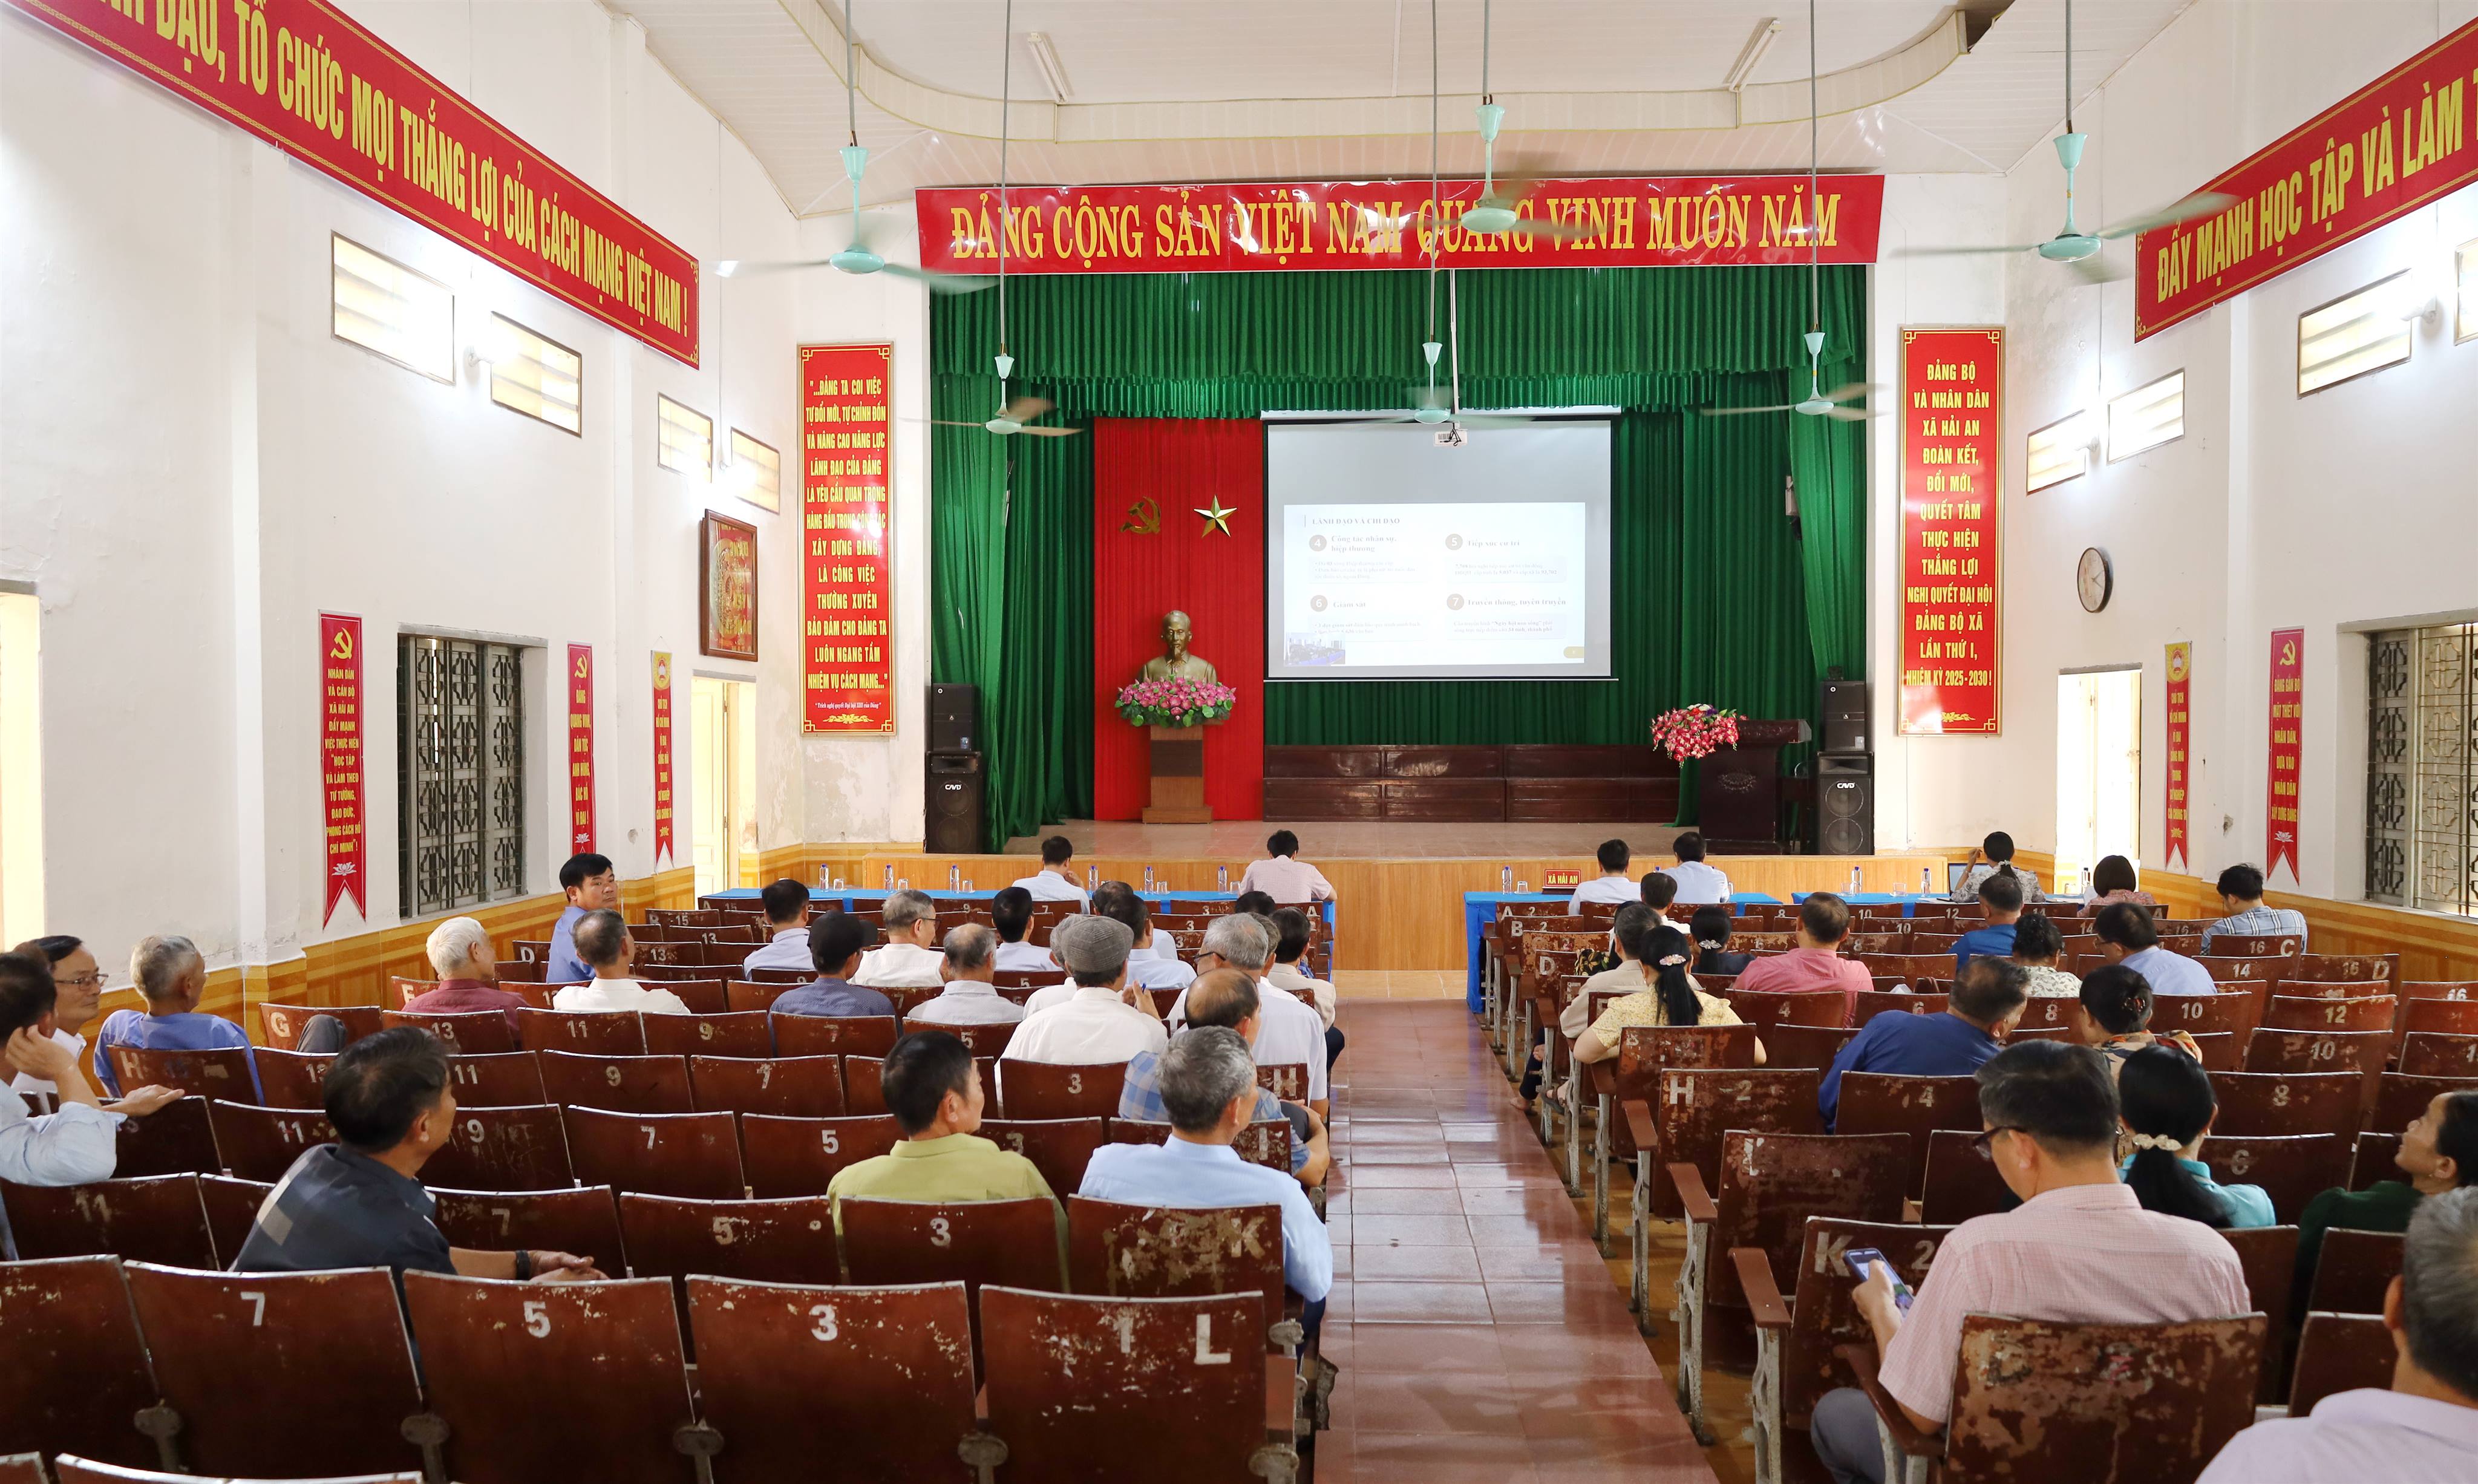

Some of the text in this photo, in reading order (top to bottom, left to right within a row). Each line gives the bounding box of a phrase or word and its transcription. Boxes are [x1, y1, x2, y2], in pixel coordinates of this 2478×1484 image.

[277, 27, 344, 140] CHỨC
[351, 73, 394, 182] MỌI
[400, 98, 466, 214] THẮNG
[471, 151, 498, 242] LỢI
[503, 160, 536, 253] CỦA
[540, 192, 580, 278] CÁCH
[584, 224, 623, 304] MẠNG
[626, 247, 652, 326] VIỆT
[655, 267, 680, 334] NAM
[2157, 216, 2192, 303] ĐẨY
[2195, 197, 2254, 286] MẠNH
[2260, 171, 2303, 257] HỌC
[2309, 137, 2353, 233] TẬP
[2361, 105, 2395, 198] VÀ
[2402, 77, 2463, 179] LÀM
[950, 193, 1044, 259] ĐẢNG
[1053, 195, 1143, 268] CỘNG
[1156, 190, 1221, 257] SẢN
[1234, 189, 1317, 264] VIỆT
[1326, 198, 1402, 253] NAM
[1546, 197, 1636, 252] VINH
[1646, 183, 1751, 249] MUÔN
[1759, 185, 1842, 247] NĂM
[1927, 359, 1976, 384] ĐẢNG BỘ
[840, 379, 849, 395] TA
[851, 379, 863, 395] COI
[866, 375, 881, 398] VIỆC
[1914, 388, 1989, 408] VÀ NHÂN DÂN
[805, 400, 886, 426] TỰ ĐỔI MỚI, TỰ CHỈNH ĐỐN
[1923, 414, 1980, 436] XÃ HẢI AN
[806, 430, 885, 452] VÀ NÂNG CAO NĂNG LỰC
[1923, 443, 1979, 466] ĐOÀN KẾT,
[810, 454, 881, 479] LÃNH ĐẠO CỦA ĐẢNG
[806, 481, 886, 505] LÀ YÊU CẦU QUAN TRỌNG
[1926, 469, 1974, 494] ĐỔI MỚI,
[806, 510, 822, 529] HÀNG
[823, 508, 835, 529] ĐẦU
[1920, 498, 1981, 521] QUYẾT TÂM
[812, 537, 827, 556] XÂY
[831, 538, 852, 559] DỰNG
[1451, 537, 1458, 546] 5
[1921, 528, 1979, 551] THỰC HIỆN
[818, 563, 875, 586] LÀ CÔNG VIỆC
[1921, 554, 1978, 578] THẮNG LỢI
[817, 590, 877, 609] THƯỜNG XUYÊN
[1315, 598, 1322, 607] 6
[1452, 598, 1459, 606] 7
[1908, 581, 1992, 607] NGHỊ QUYẾT ĐẠI HỘI
[807, 615, 887, 636] BẢO ĐẢM CHO ĐẢNG TA
[1915, 609, 1983, 634] ĐẢNG BỘ XÃ
[815, 641, 880, 662] LUÔN NGANG TẦM
[1920, 636, 1941, 659] LẦN
[1945, 639, 1967, 658] THỨ
[808, 670, 829, 693] NHIỆM
[831, 673, 839, 693] VỤ
[840, 670, 858, 689] CÁCH
[1906, 666, 1931, 689] NHIỆM
[1934, 667, 1943, 686] KỲ
[347, 704, 355, 714] AN
[346, 773, 359, 783] THEO
[1548, 872, 1578, 884] XÃ HẢI AN
[1511, 921, 1523, 937] B
[2250, 939, 2295, 958] 16 C
[1539, 957, 1555, 975] D
[2372, 960, 2389, 980] D
[2182, 1002, 2203, 1020] 10
[2325, 1006, 2346, 1023] 12
[270, 1012, 290, 1038] G
[567, 1021, 587, 1038] 11
[699, 1022, 713, 1041] 9
[2312, 1041, 2335, 1060] 10
[454, 1064, 478, 1085] 11
[606, 1065, 621, 1087] 9
[757, 1064, 771, 1089] 7
[1067, 1073, 1082, 1094] 3
[1669, 1076, 1752, 1104] H 2
[467, 1120, 484, 1142] 9
[641, 1126, 656, 1149] 7
[822, 1129, 839, 1154] 5
[929, 1217, 952, 1247] 3
[1815, 1231, 1851, 1276] K
[240, 1291, 265, 1327] 7
[523, 1301, 550, 1338] 5
[808, 1304, 838, 1342] 3
[1194, 1313, 1232, 1365] L
